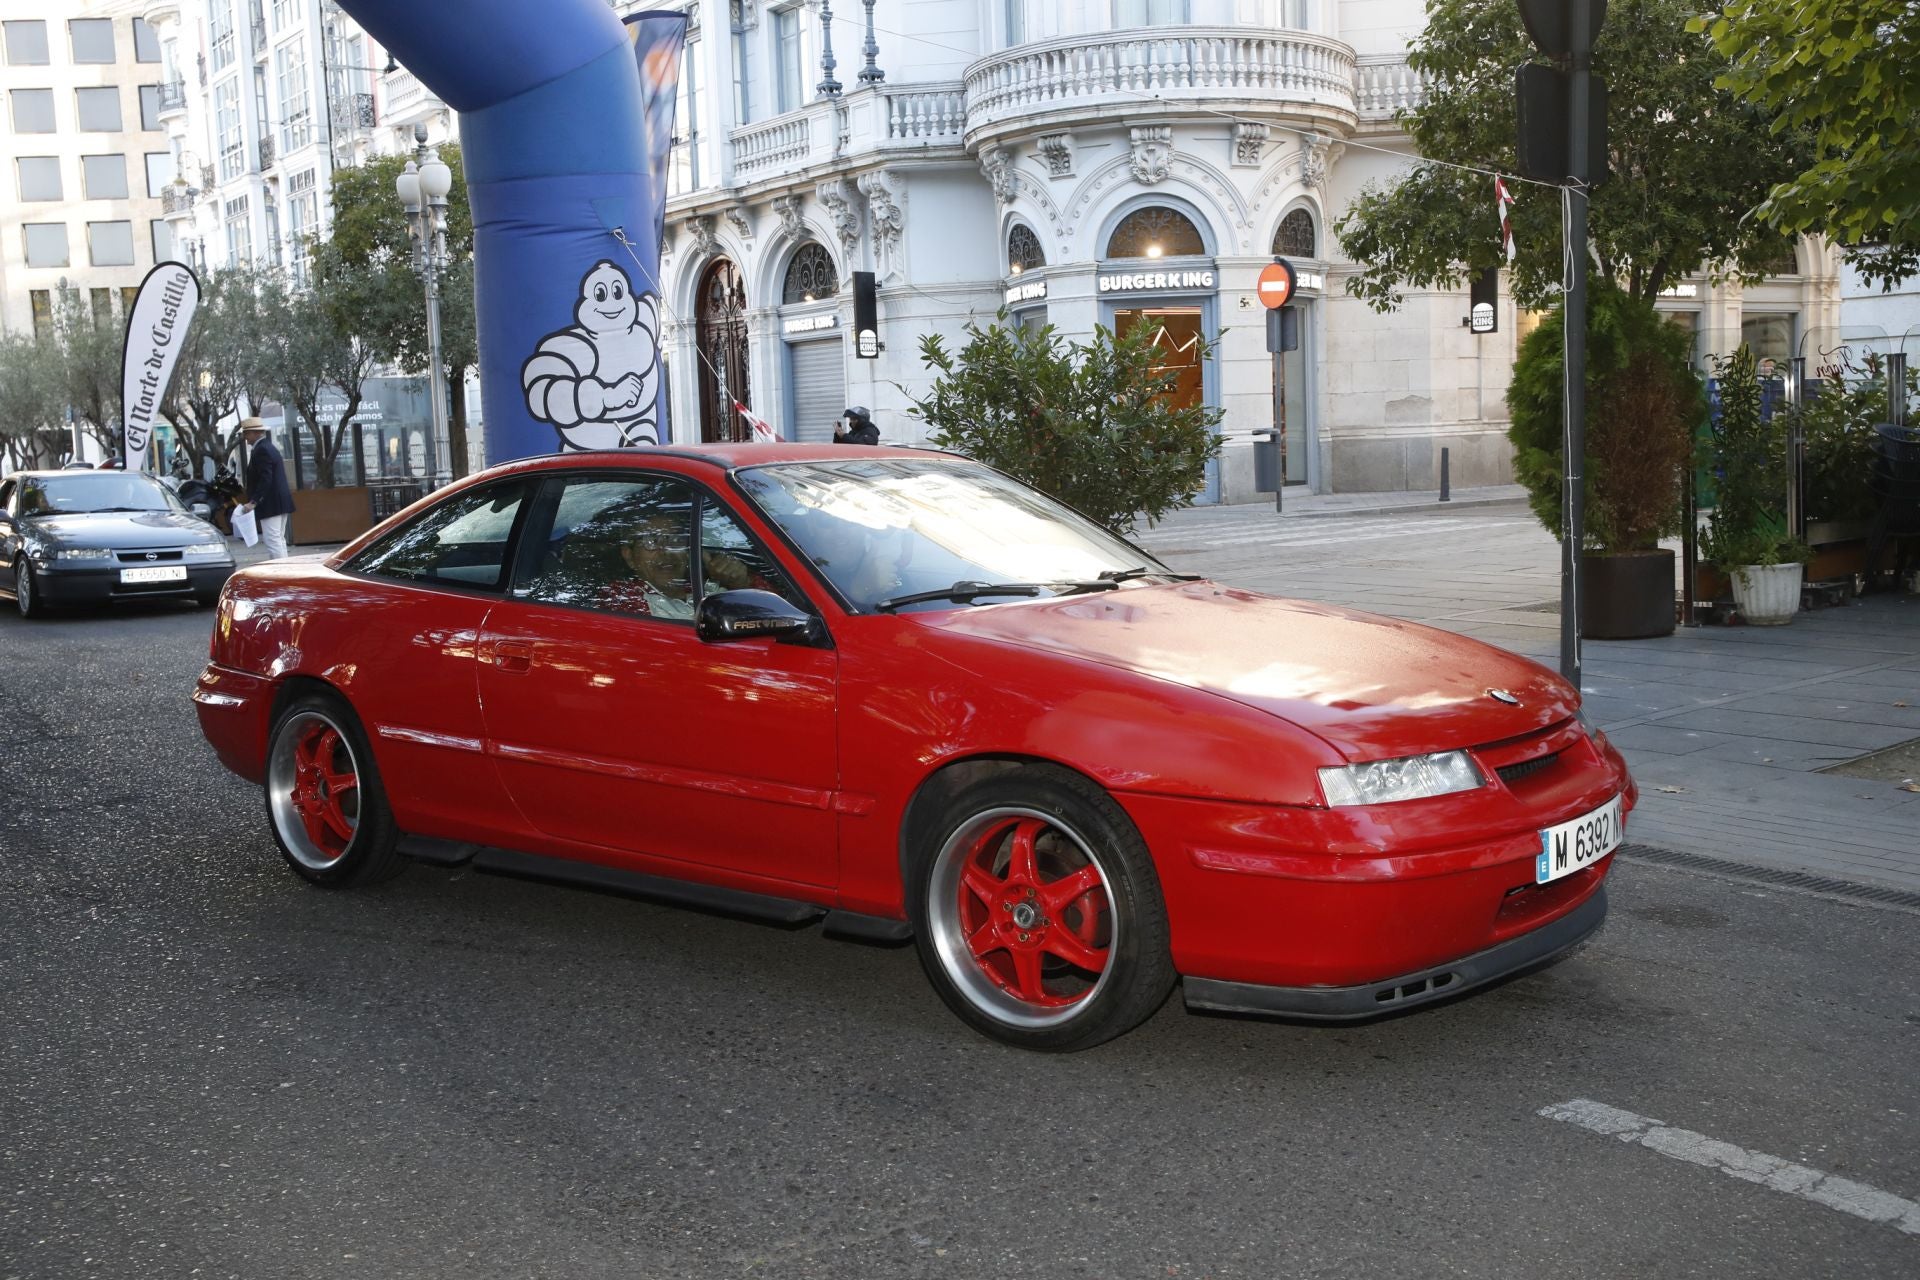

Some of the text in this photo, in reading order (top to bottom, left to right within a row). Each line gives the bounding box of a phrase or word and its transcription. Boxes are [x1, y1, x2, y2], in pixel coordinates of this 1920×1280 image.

[1100, 272, 1213, 292] BURGER KING
[1473, 317, 1493, 326] KING
[860, 343, 876, 351] KING
[127, 272, 190, 452] El Norte de Castilla
[1555, 831, 1567, 871] M
[1576, 813, 1609, 862] 6392
[1541, 861, 1547, 873] E
